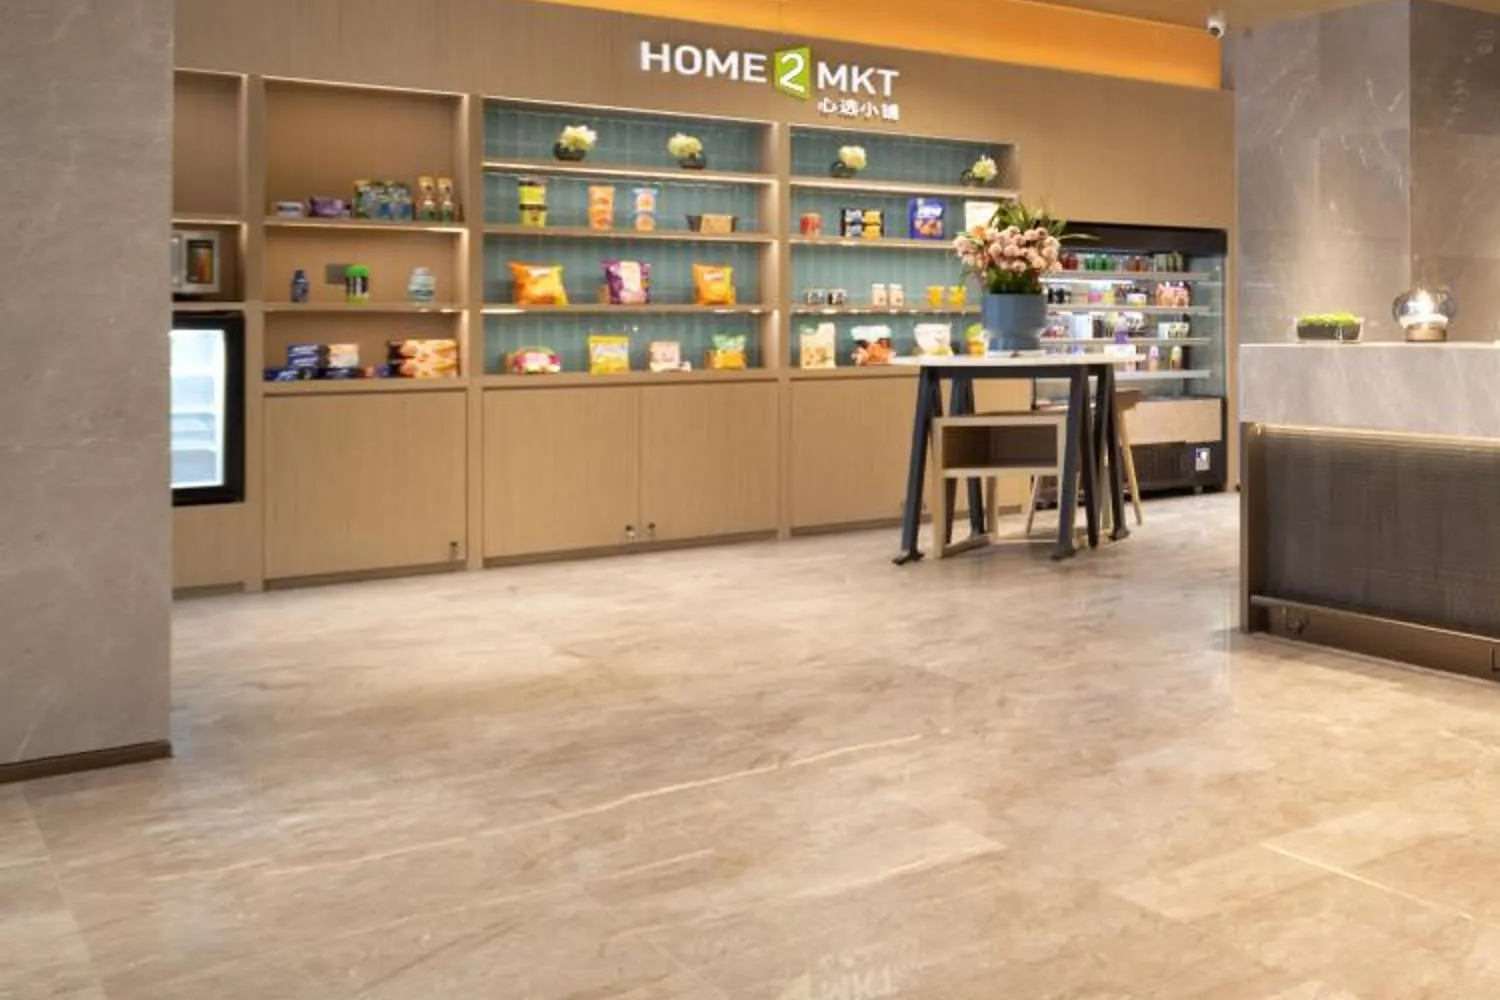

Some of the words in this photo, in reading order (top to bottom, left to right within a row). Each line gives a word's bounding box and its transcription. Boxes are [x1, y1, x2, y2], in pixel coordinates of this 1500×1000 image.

[640, 40, 768, 84] HOME
[779, 52, 806, 93] 2
[817, 61, 900, 97] MKT
